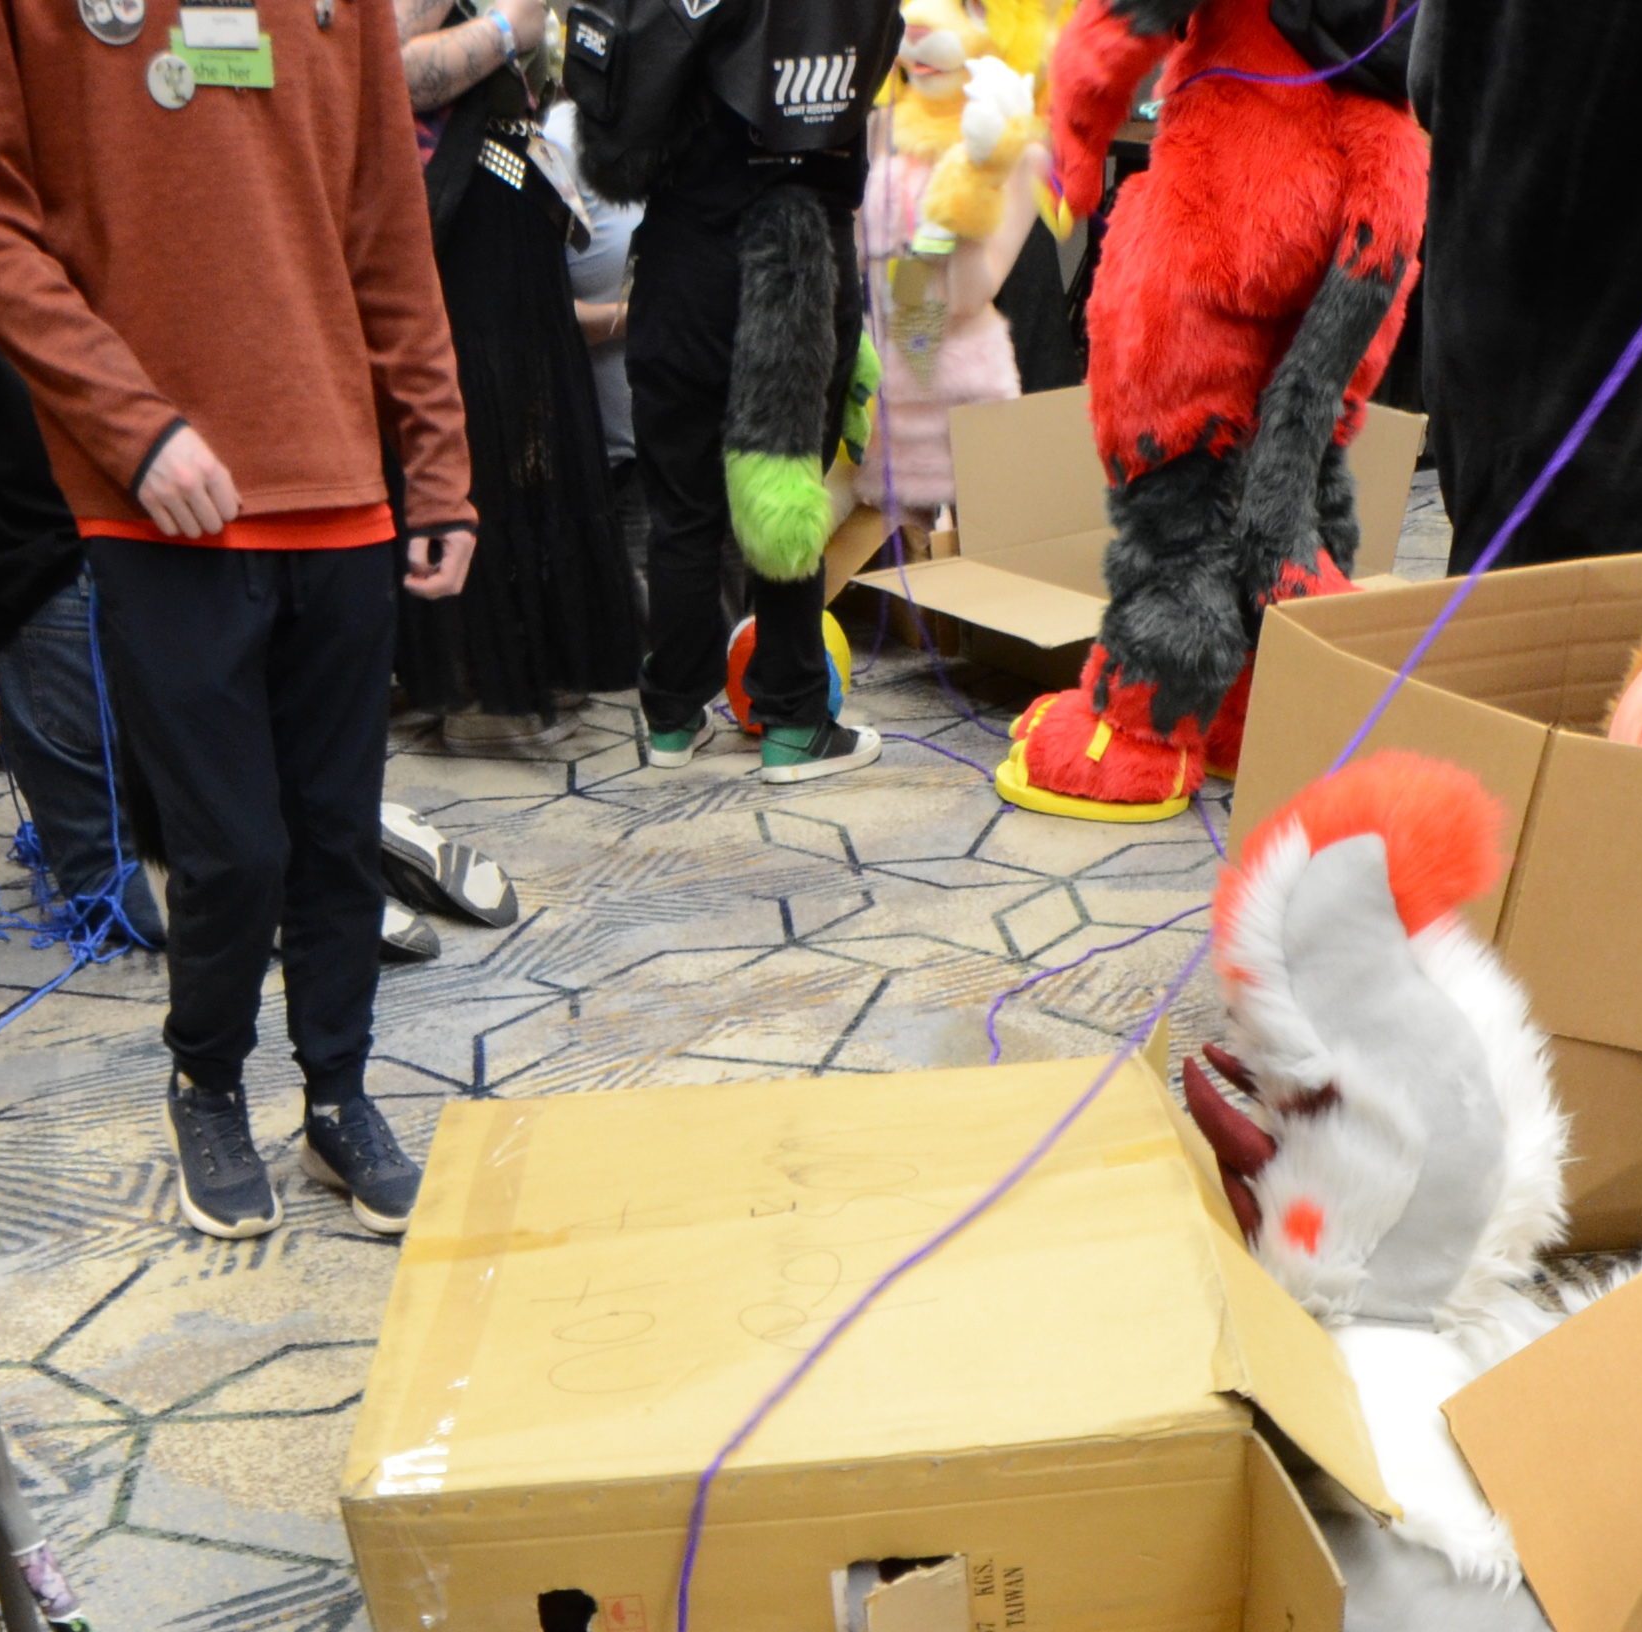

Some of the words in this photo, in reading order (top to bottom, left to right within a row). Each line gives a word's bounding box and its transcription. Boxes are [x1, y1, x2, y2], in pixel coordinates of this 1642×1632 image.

[193, 63, 218, 80] she
[228, 65, 251, 81] her
[973, 1558, 996, 1597] KGS.
[1003, 1566, 1025, 1628] TAIWAN
